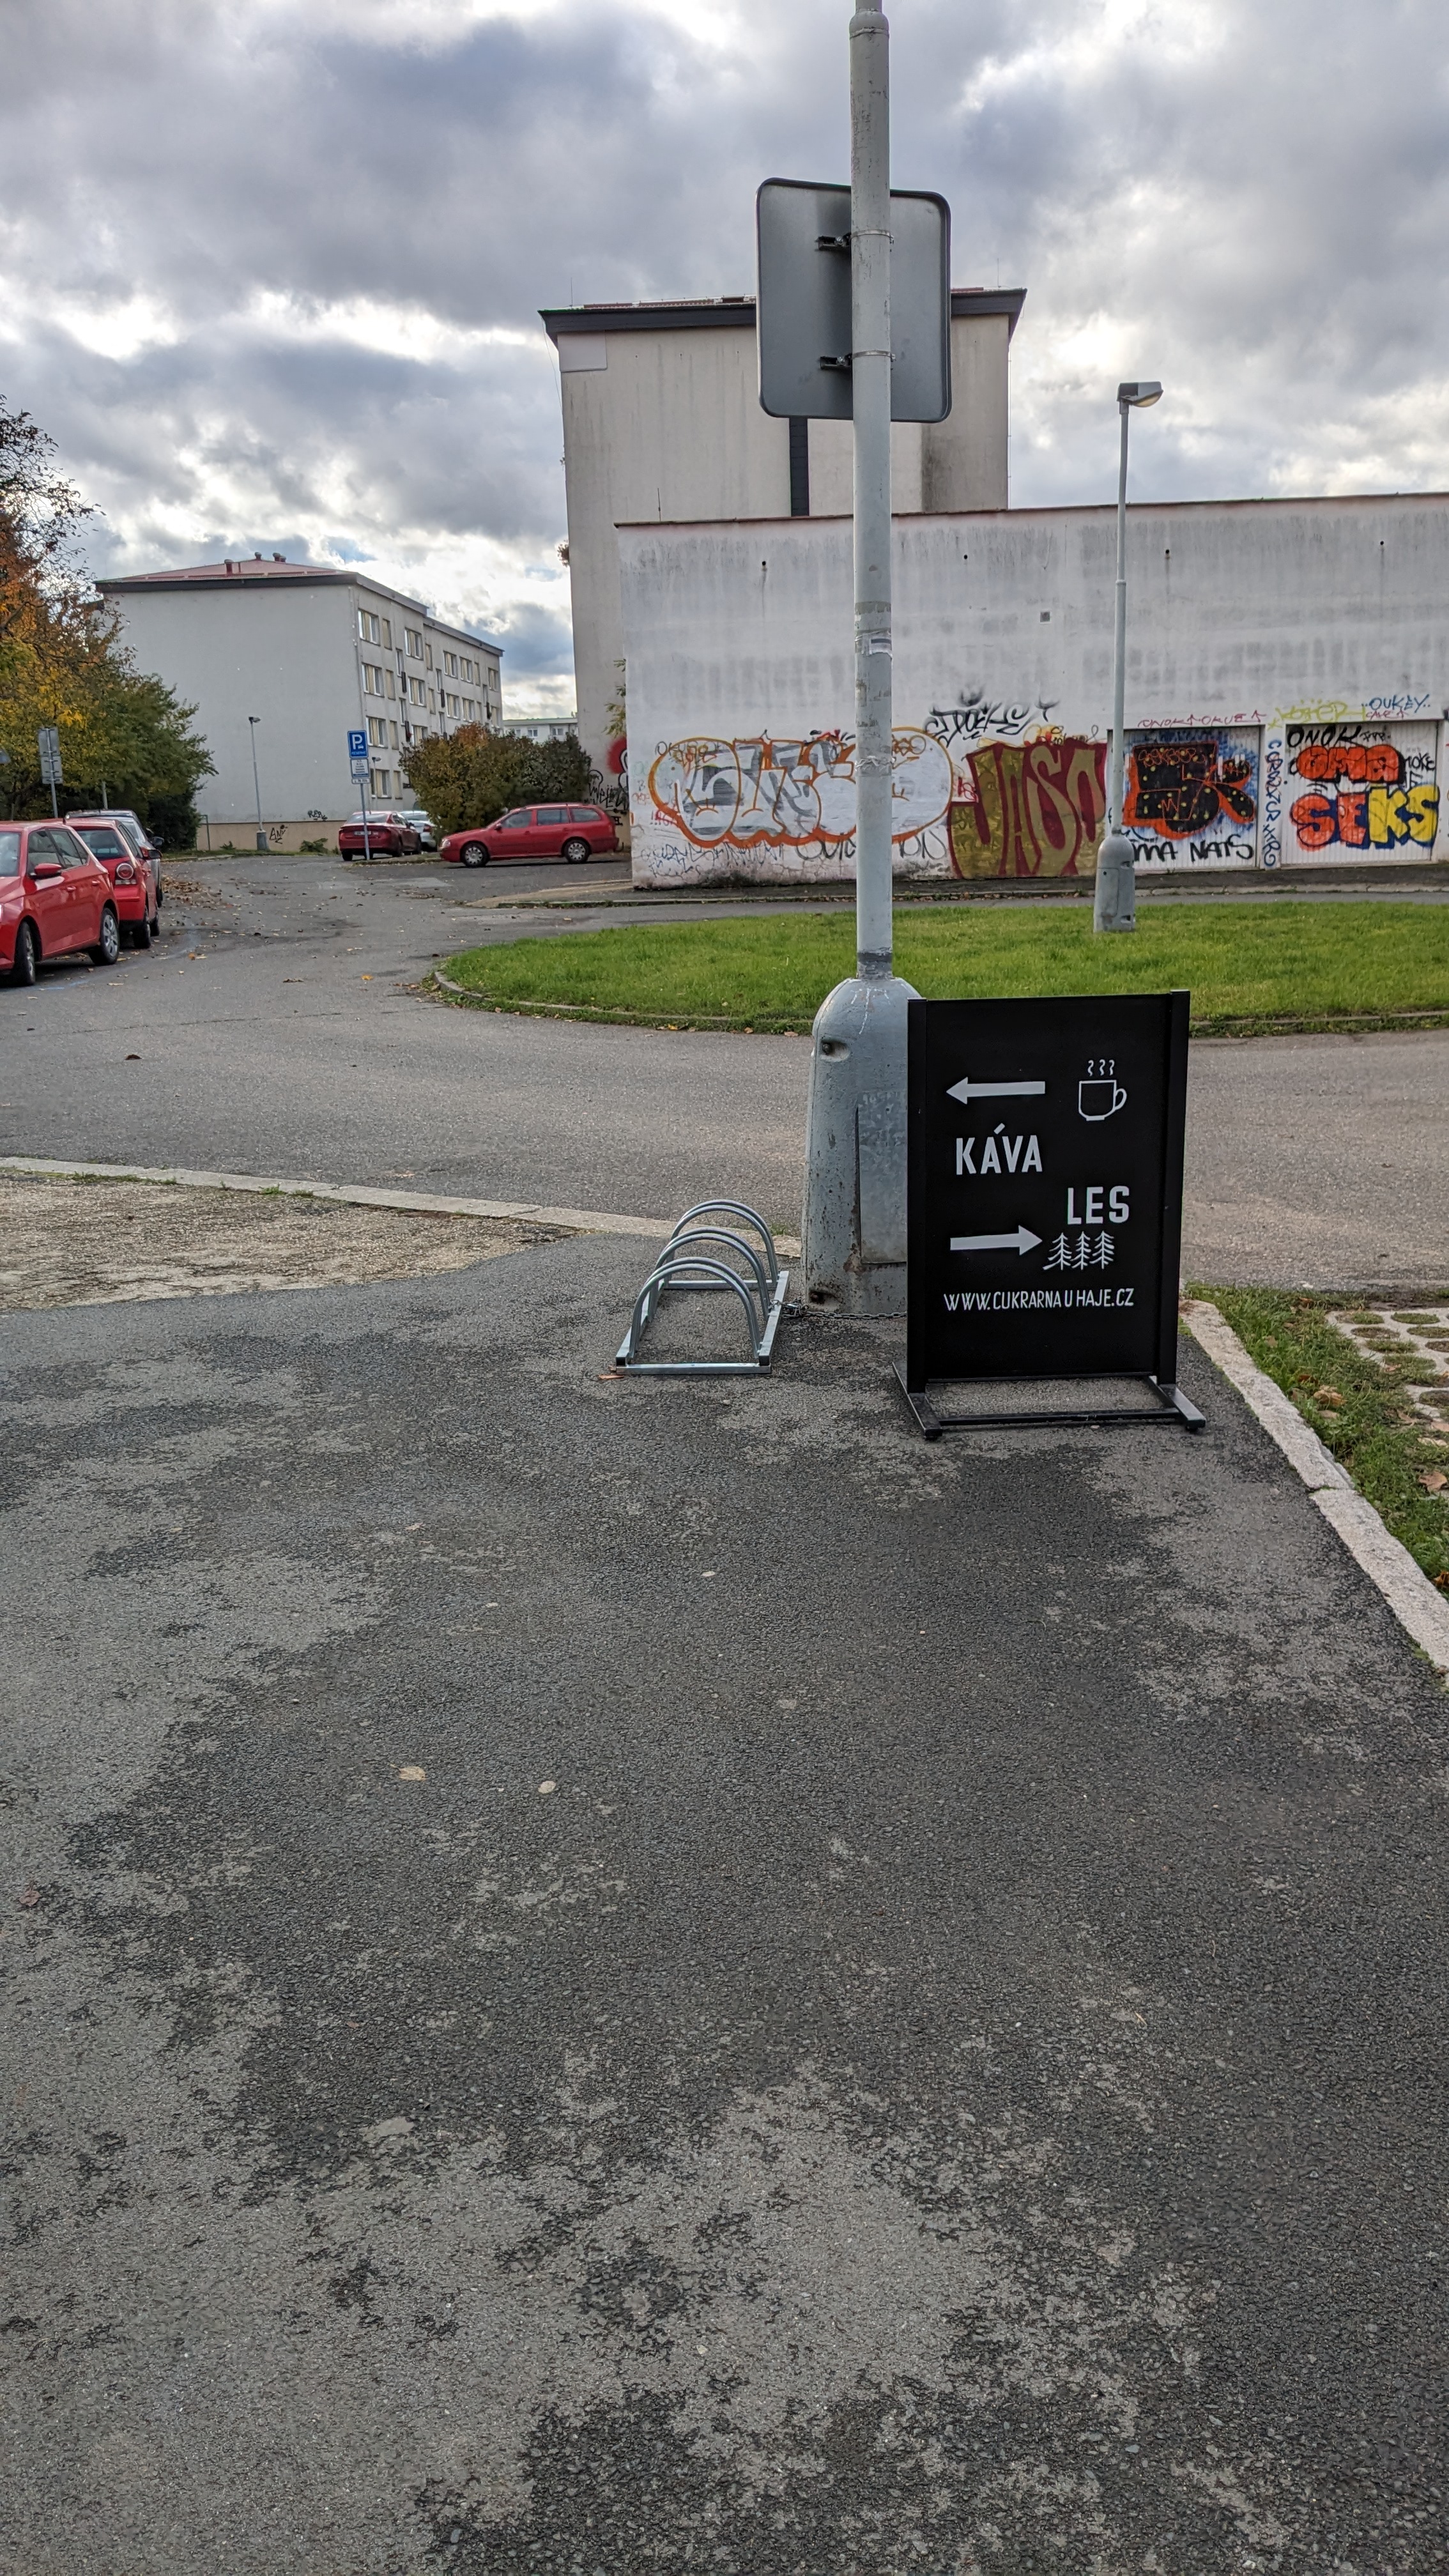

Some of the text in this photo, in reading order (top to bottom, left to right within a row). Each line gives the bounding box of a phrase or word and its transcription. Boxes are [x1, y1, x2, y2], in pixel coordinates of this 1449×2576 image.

[1289, 783, 1439, 852] SEKS
[956, 1123, 1043, 1176] KÁVA
[1067, 1185, 1130, 1225] LES
